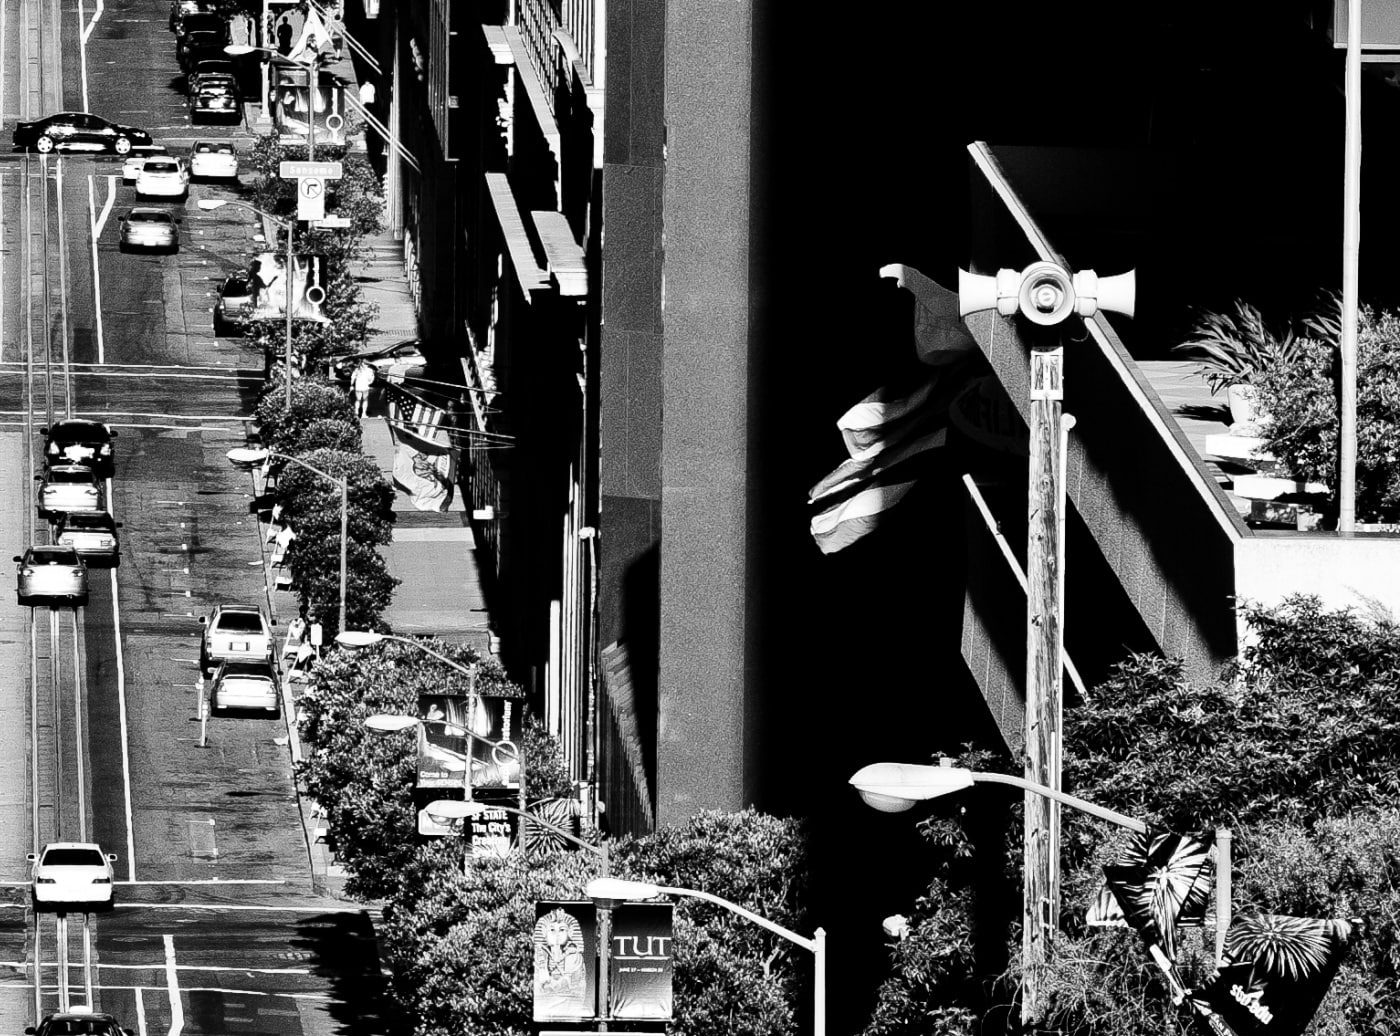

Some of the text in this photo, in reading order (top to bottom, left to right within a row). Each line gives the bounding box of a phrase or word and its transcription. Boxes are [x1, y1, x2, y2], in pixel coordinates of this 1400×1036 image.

[483, 810, 508, 820] STATE
[471, 821, 511, 836] The City's
[613, 935, 672, 956] TUT
